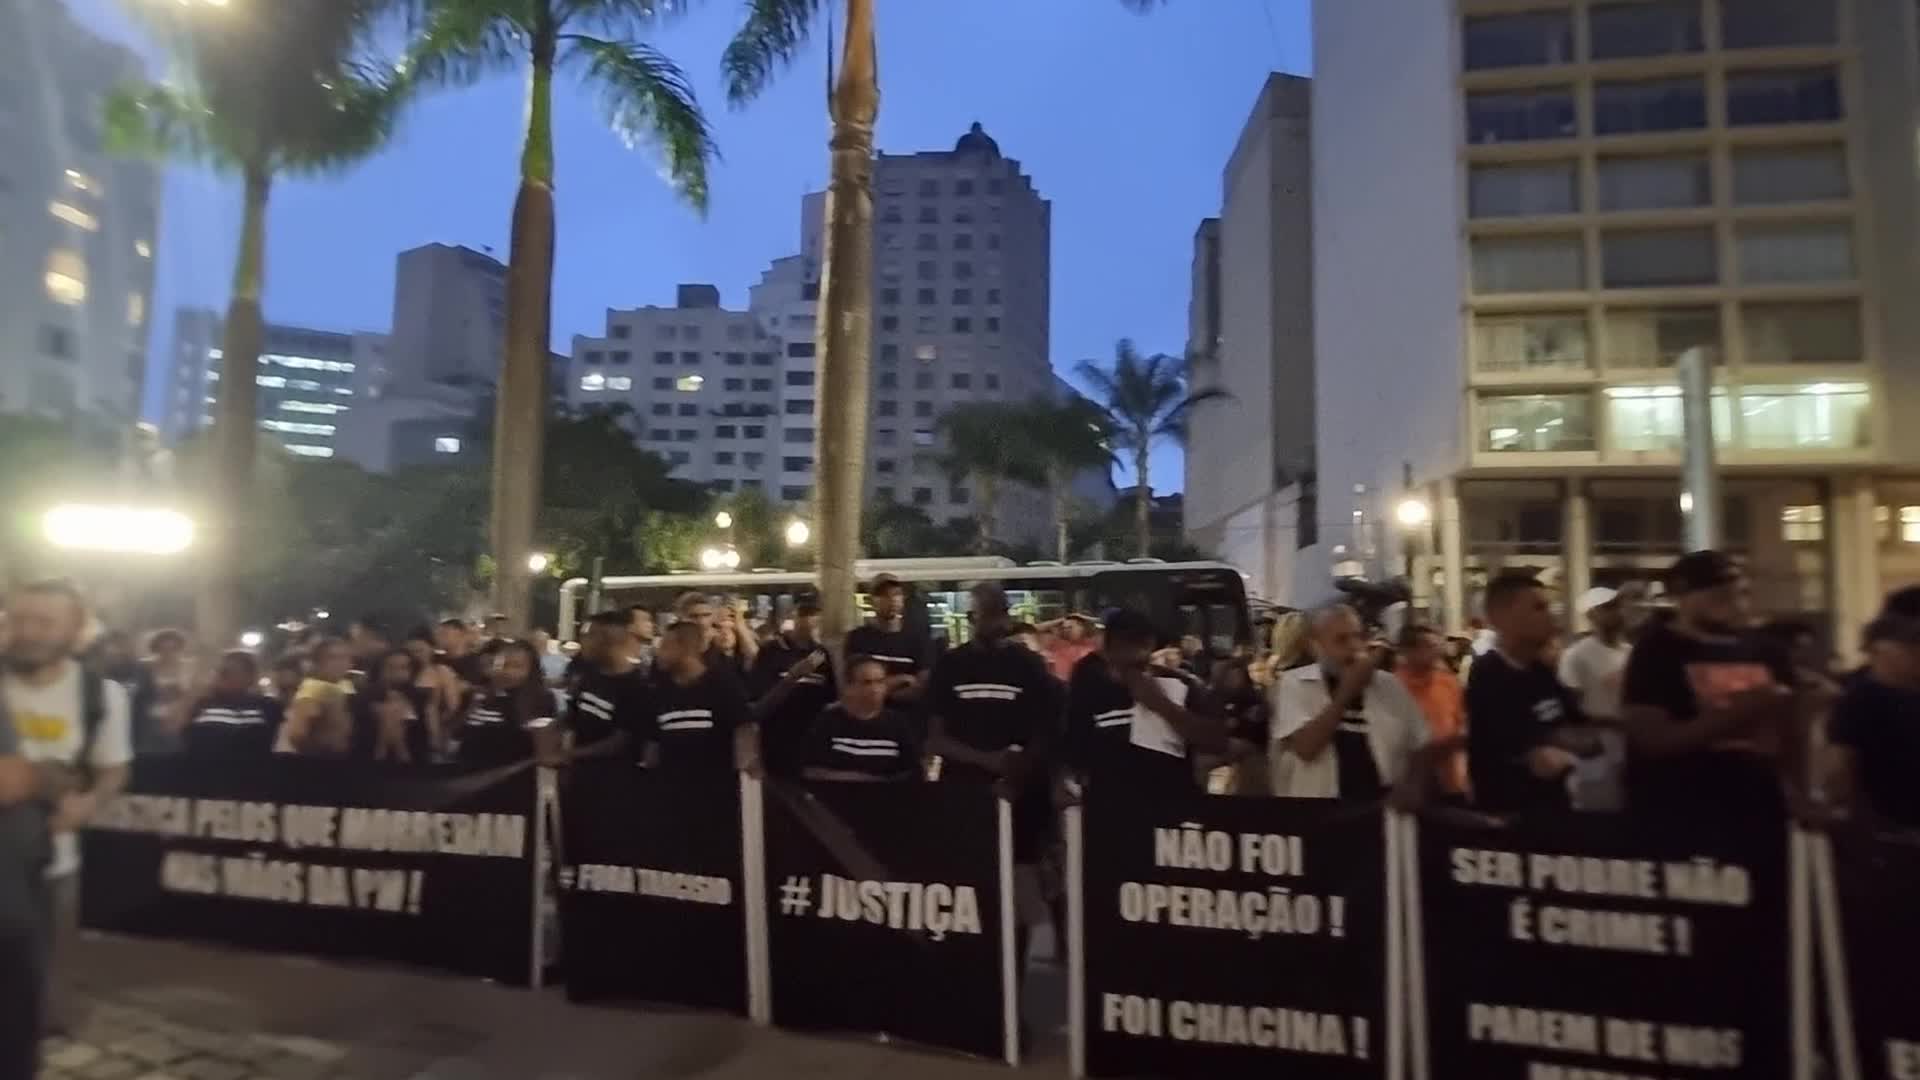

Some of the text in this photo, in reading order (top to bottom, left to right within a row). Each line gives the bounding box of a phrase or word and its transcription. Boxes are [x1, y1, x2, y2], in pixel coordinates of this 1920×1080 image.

[1155, 821, 1304, 876] NÃO FOI
[1450, 847, 1524, 888] SER
[779, 873, 983, 942] # JUSTIÇA
[1119, 881, 1345, 941] OPERAÇÃO !
[1509, 897, 1535, 941] É
[1540, 904, 1669, 954] CRIME
[1103, 992, 1370, 1060] FOI CHACINA !
[1467, 1003, 1599, 1054] PAREM
